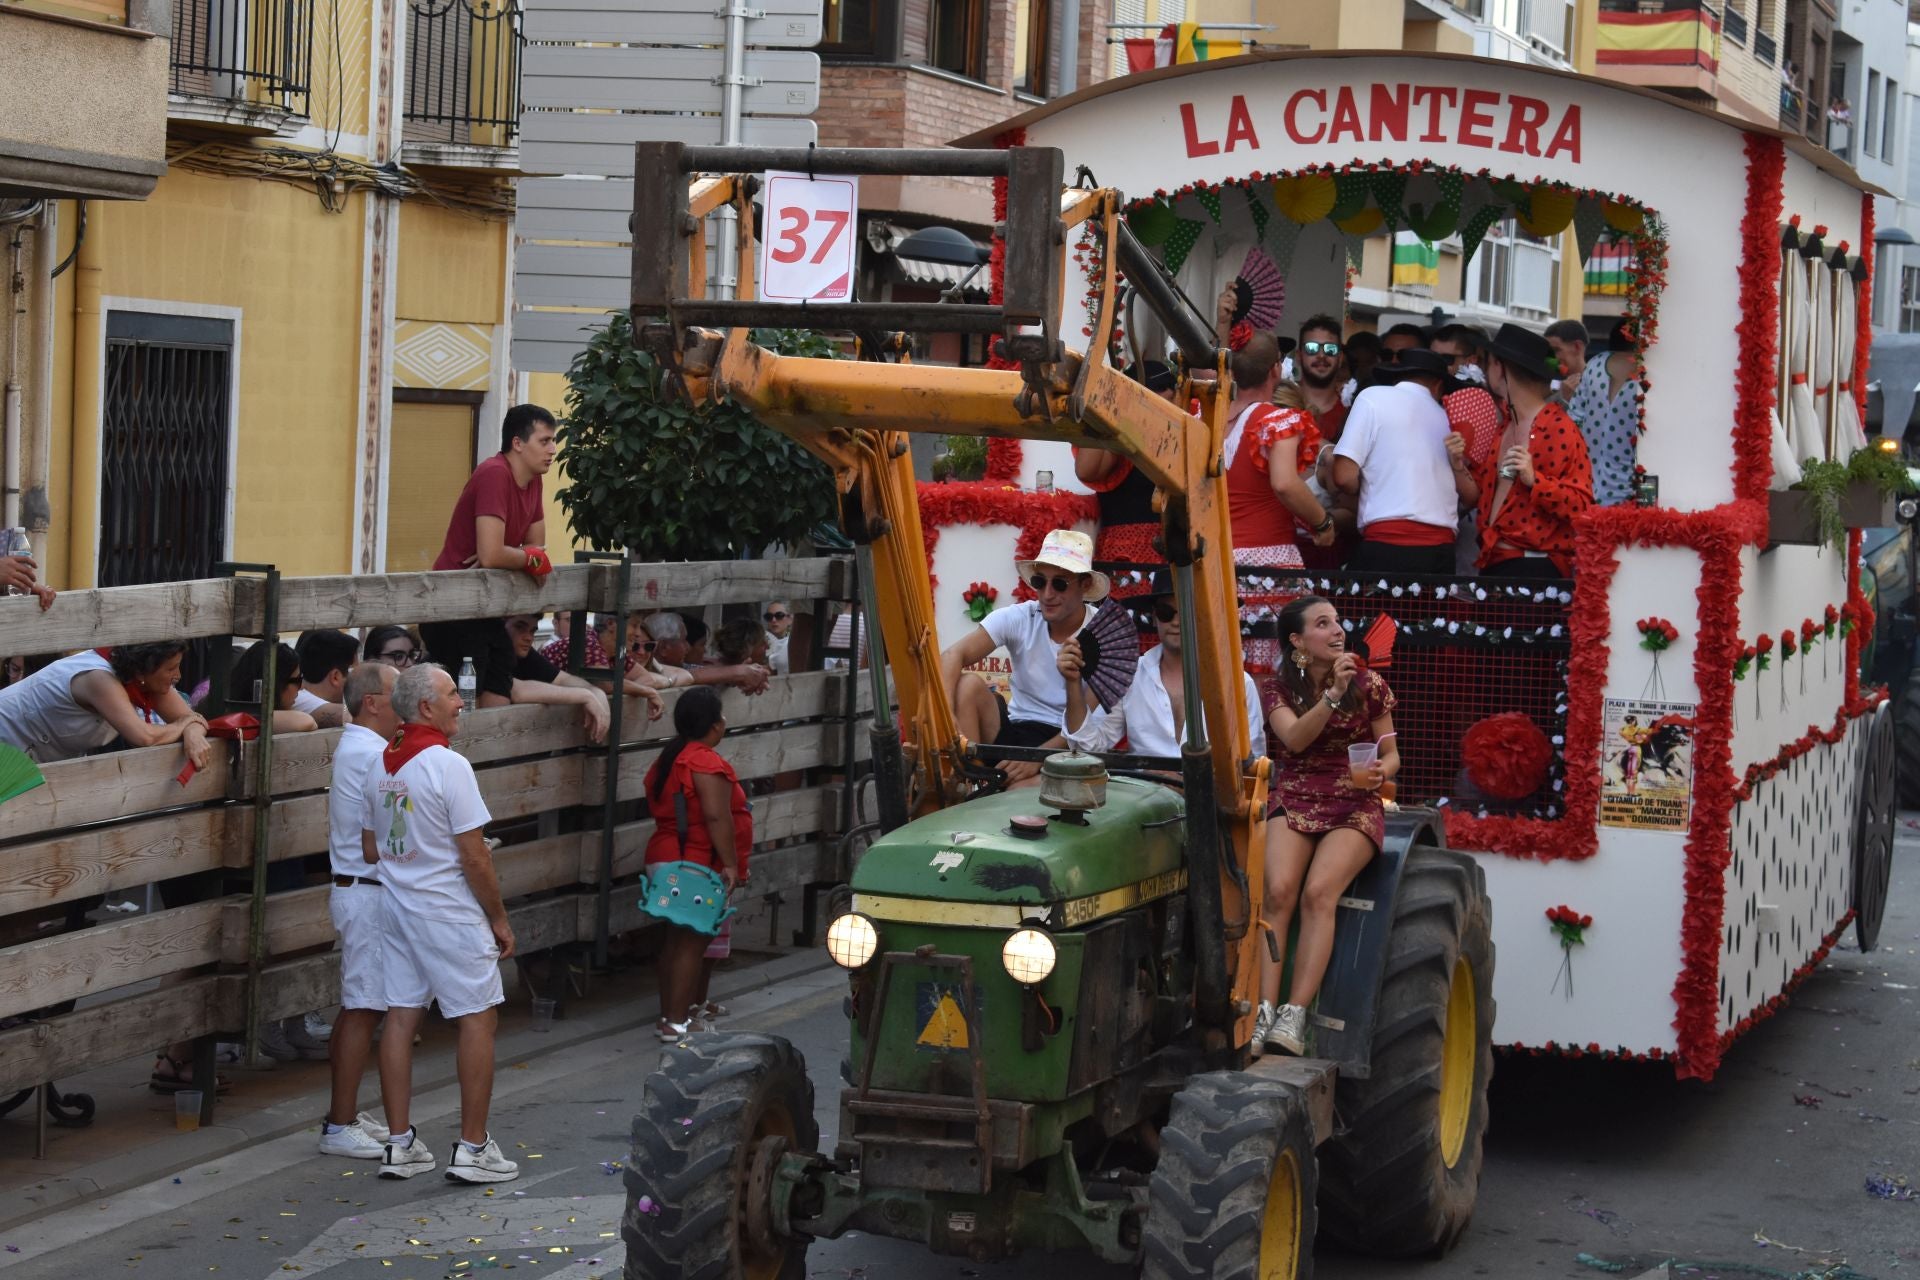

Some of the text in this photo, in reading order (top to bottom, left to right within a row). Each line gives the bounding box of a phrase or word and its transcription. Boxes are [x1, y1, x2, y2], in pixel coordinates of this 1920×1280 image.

[1179, 83, 1581, 164] LA CANTERA
[770, 206, 849, 264] 37
[1645, 798, 1655, 806] DE
